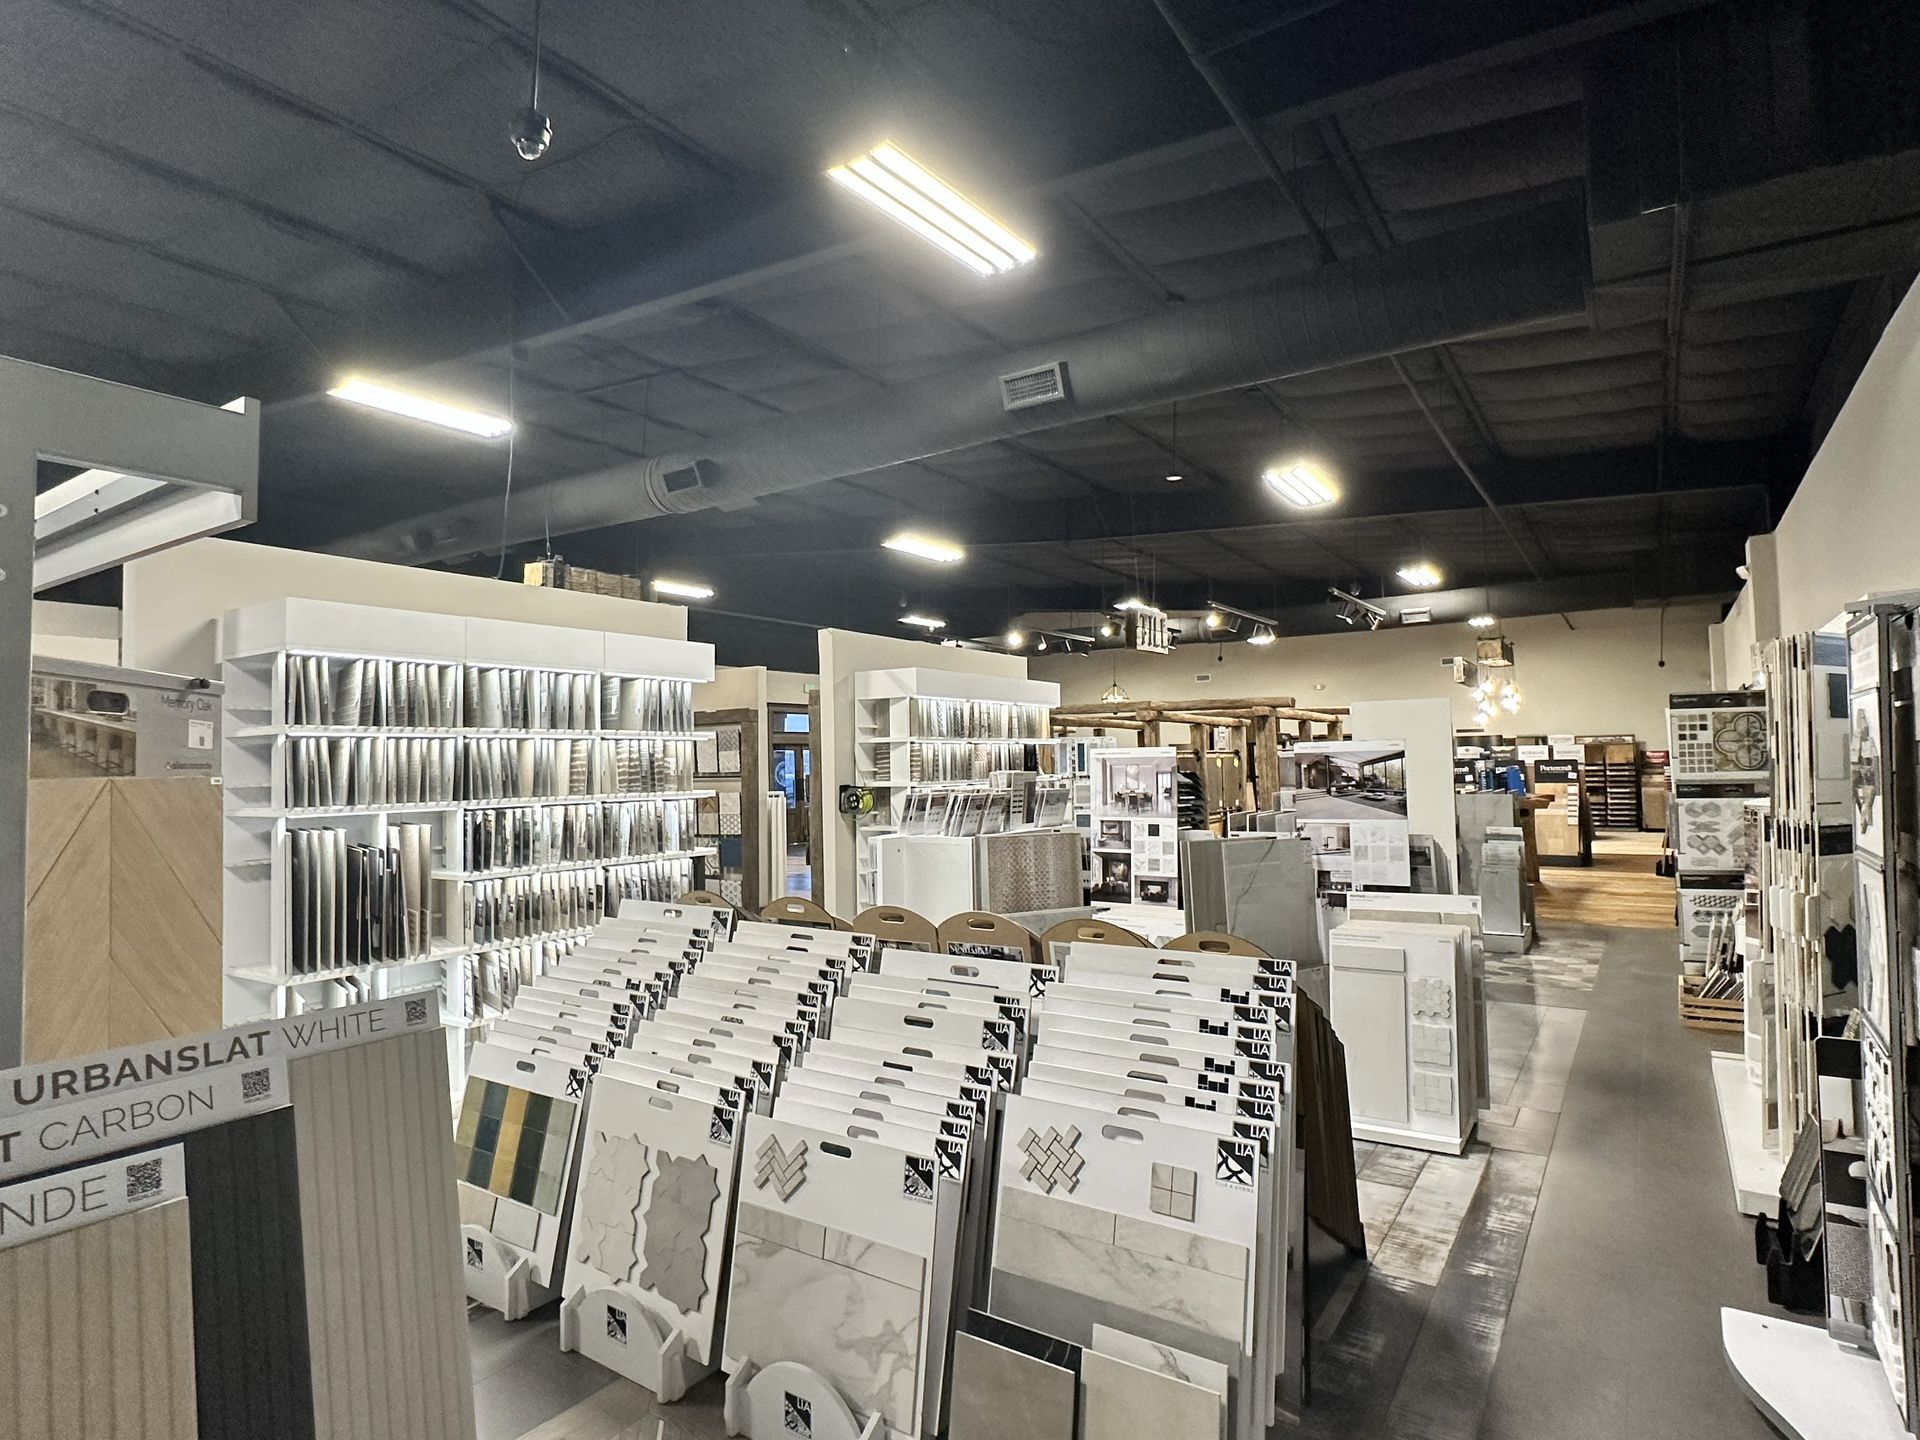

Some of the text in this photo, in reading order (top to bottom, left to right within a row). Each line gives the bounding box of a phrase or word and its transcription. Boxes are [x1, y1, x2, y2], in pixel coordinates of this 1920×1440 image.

[161, 694, 213, 713] Memory Oak
[1274, 960, 1292, 972] LIA
[1042, 970, 1056, 980] LIA
[1268, 977, 1286, 990] LIA
[1274, 996, 1291, 1008] LIA
[1011, 1007, 1025, 1018] LIA
[1250, 1008, 1268, 1020] LIA
[995, 1022, 1010, 1034] LIA
[1253, 1028, 1270, 1042] LIA
[1252, 1042, 1270, 1056] LIA
[13, 1008, 386, 1106] URBANSLAT WHITE
[999, 1057, 1013, 1070] LIA
[978, 1067, 992, 1080] LIA
[1266, 1063, 1285, 1078] LIA
[972, 1089, 986, 1100] LIA
[1256, 1084, 1274, 1100] LIA
[959, 1104, 974, 1117] LIA
[1254, 1102, 1274, 1118] LIA
[39, 1085, 214, 1151] CARBON
[953, 1122, 967, 1135] LIA
[1250, 1124, 1270, 1140] LIA
[948, 1141, 962, 1155] LIA
[1234, 1142, 1254, 1158] LIA
[919, 1158, 934, 1172] LIA
[0, 1175, 108, 1235] NDE
[796, 1396, 812, 1414] LIA
